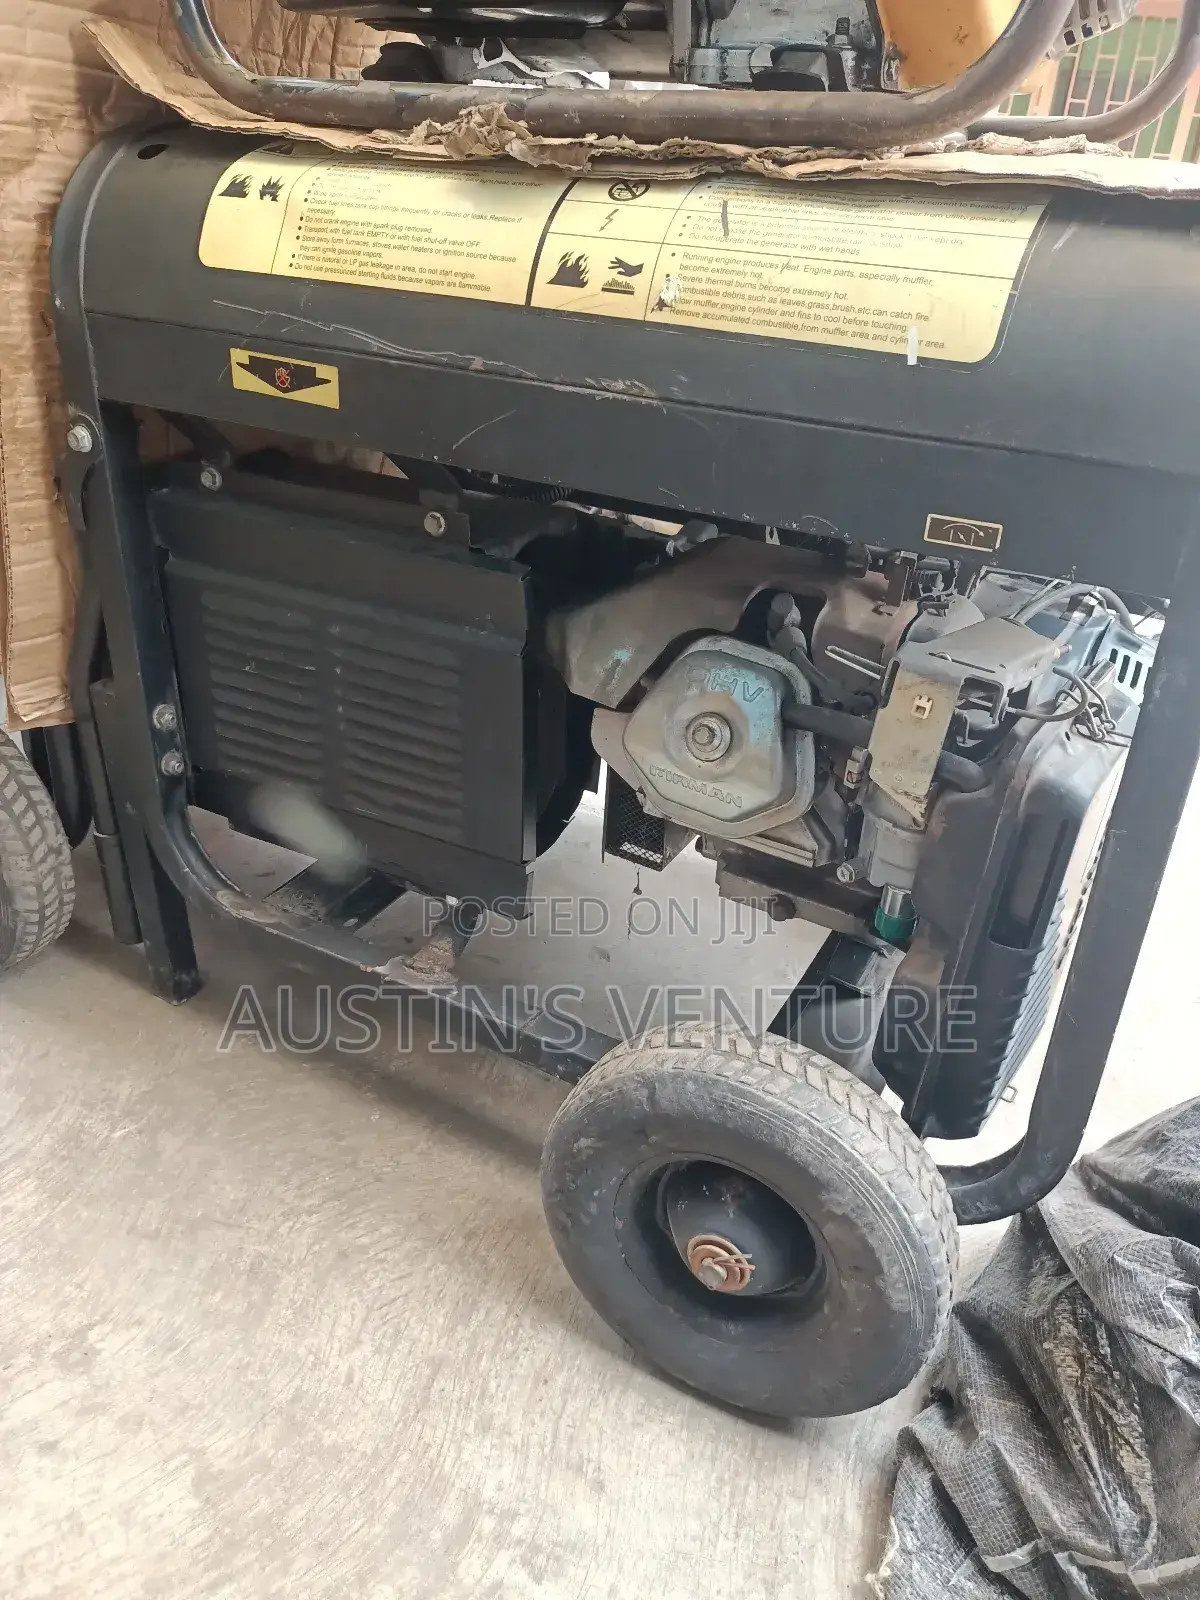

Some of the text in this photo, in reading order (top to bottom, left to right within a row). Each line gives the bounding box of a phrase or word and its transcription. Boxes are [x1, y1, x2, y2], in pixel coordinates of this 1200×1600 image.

[442, 210, 461, 218] cracks
[304, 226, 328, 234] Transport
[366, 230, 390, 238] EMPTY
[411, 234, 423, 242] fuel
[424, 236, 448, 244] shut-off
[448, 238, 464, 247] valve
[360, 220, 372, 228] with
[373, 222, 390, 230] spark
[390, 223, 404, 232] plug
[405, 225, 432, 234] removed.
[300, 244, 310, 252] they
[338, 248, 362, 256] gasoline
[362, 250, 384, 260] vapors.
[302, 234, 316, 242] Store
[410, 245, 434, 254] heaters
[442, 248, 464, 258] ignition
[466, 252, 488, 260] source
[488, 254, 516, 263] because
[688, 232, 700, 240] Do
[746, 238, 759, 246] the
[760, 240, 798, 250] generator
[800, 242, 816, 252] with
[818, 245, 834, 254] wet
[834, 245, 860, 256] hands
[294, 262, 302, 270] Do
[324, 266, 358, 276] pressurized
[358, 268, 380, 280] starting
[380, 270, 396, 282] fluids
[398, 273, 424, 283] because
[424, 278, 445, 288] vapors
[446, 280, 457, 288] are
[302, 254, 316, 262] there
[349, 258, 358, 266] LP
[358, 260, 370, 268] gas
[370, 260, 394, 271] leakage
[402, 265, 417, 274] area,
[418, 266, 426, 274] do
[439, 268, 453, 277] start
[679, 262, 710, 274] become
[710, 267, 749, 280] extremely
[682, 251, 714, 264] Running
[715, 256, 742, 267] engine
[742, 258, 779, 271] produces
[804, 264, 832, 276] Engine
[832, 268, 856, 280] parts,
[858, 270, 901, 284] especially
[902, 275, 934, 288] muffler,
[704, 276, 734, 288] thermal
[734, 279, 757, 290] burns
[758, 282, 790, 295] become
[792, 286, 832, 300] extremely
[833, 290, 849, 301] hot.
[747, 304, 778, 317] cylinder
[780, 306, 796, 318] and
[797, 310, 812, 321] fins
[814, 312, 822, 321] to
[823, 312, 842, 324] cool
[842, 314, 869, 327] before
[768, 295, 778, 304] as
[889, 308, 913, 321] catch
[915, 312, 930, 322] fire
[669, 306, 701, 319] Remove
[702, 311, 750, 325] accumulated
[820, 326, 849, 338] muffler
[850, 330, 870, 341] area
[871, 330, 888, 342] and
[925, 338, 945, 349] area
[650, 764, 743, 809] FIRMAN
